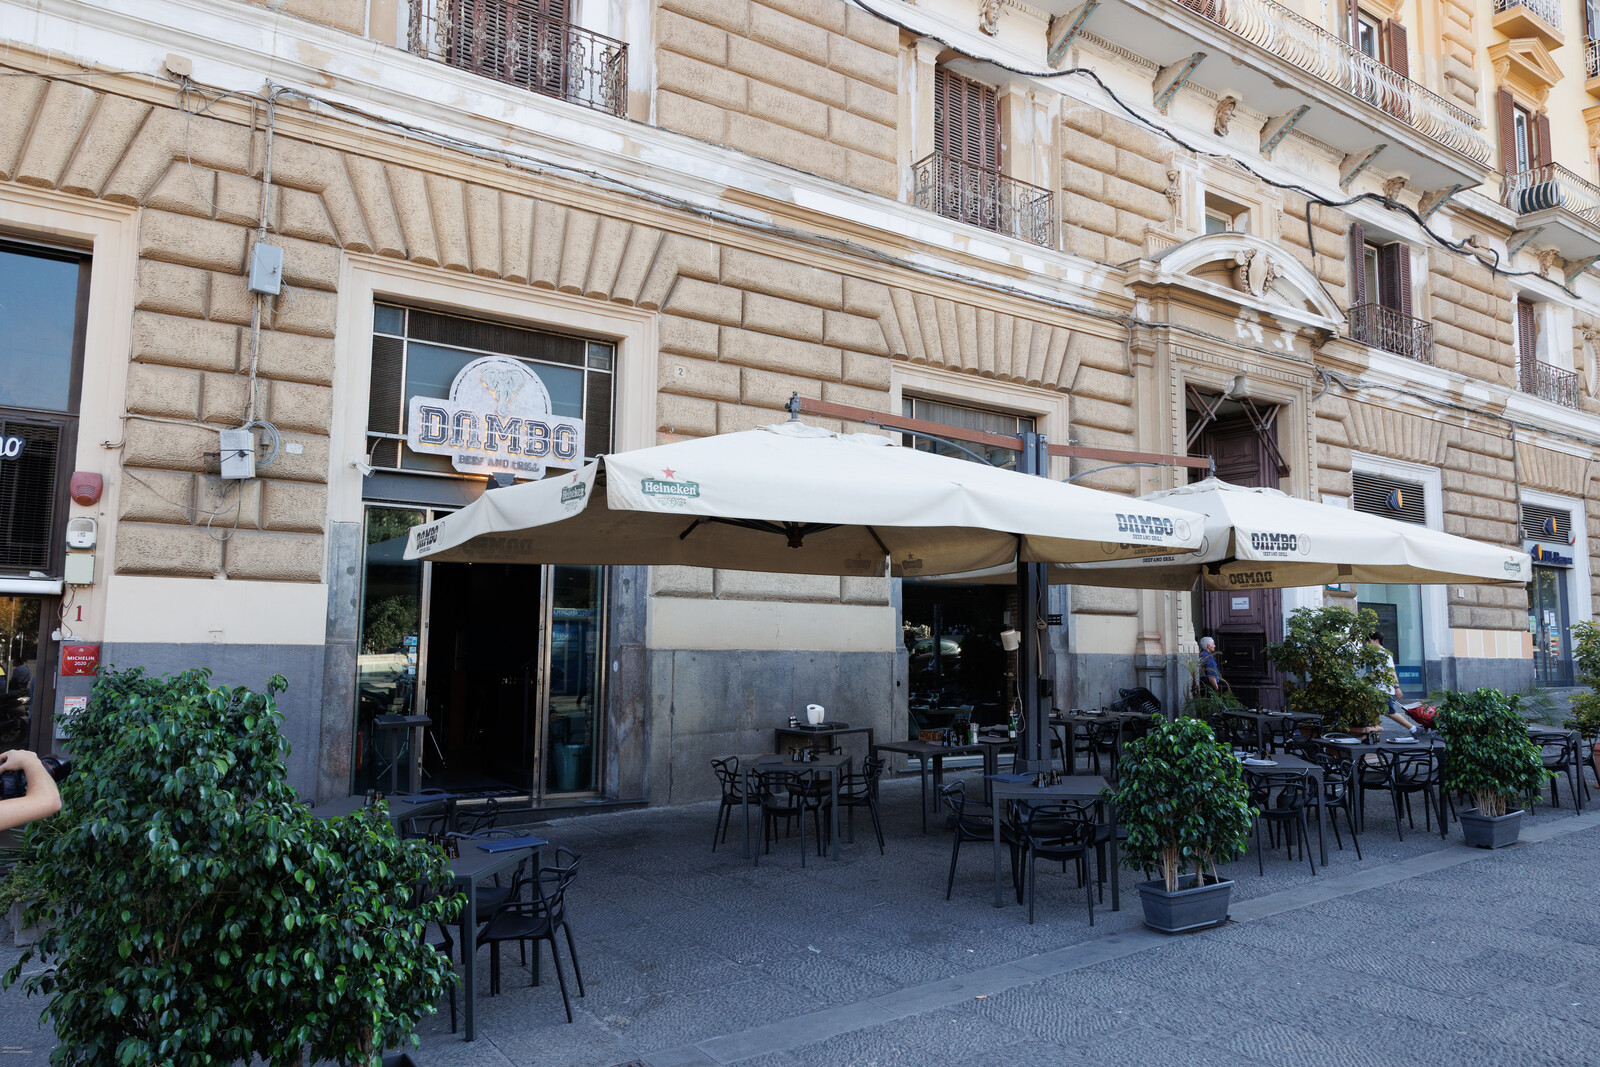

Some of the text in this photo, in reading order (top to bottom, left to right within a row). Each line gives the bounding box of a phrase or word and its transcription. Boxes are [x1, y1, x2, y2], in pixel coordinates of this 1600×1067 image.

[678, 367, 683, 376] 2
[458, 454, 484, 466] BEEF
[487, 458, 509, 469] AND
[644, 481, 697, 495] Heineken
[75, 605, 83, 622] 1
